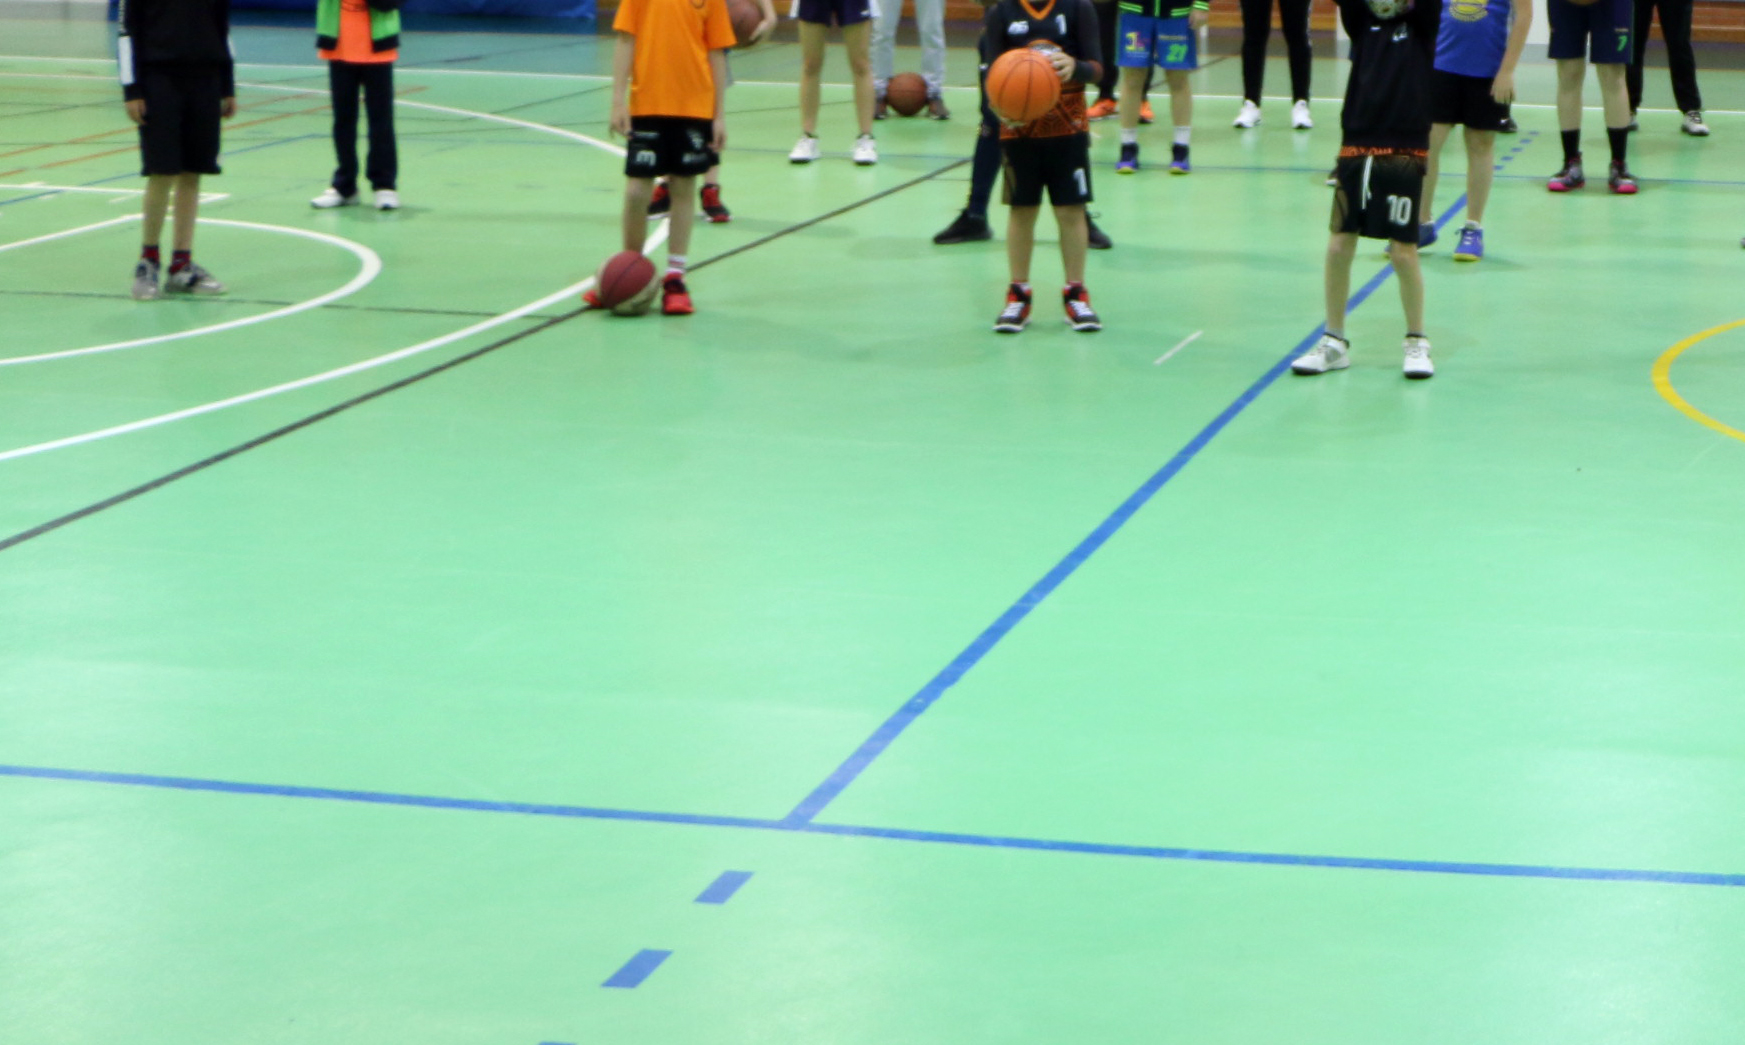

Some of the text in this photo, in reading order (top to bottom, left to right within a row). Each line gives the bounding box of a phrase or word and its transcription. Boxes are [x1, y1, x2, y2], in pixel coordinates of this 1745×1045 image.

[1055, 14, 1067, 35] 1
[1166, 44, 1188, 63] 21
[1617, 35, 1628, 52] 7
[1073, 168, 1088, 195] 1
[1387, 194, 1412, 225] 10
